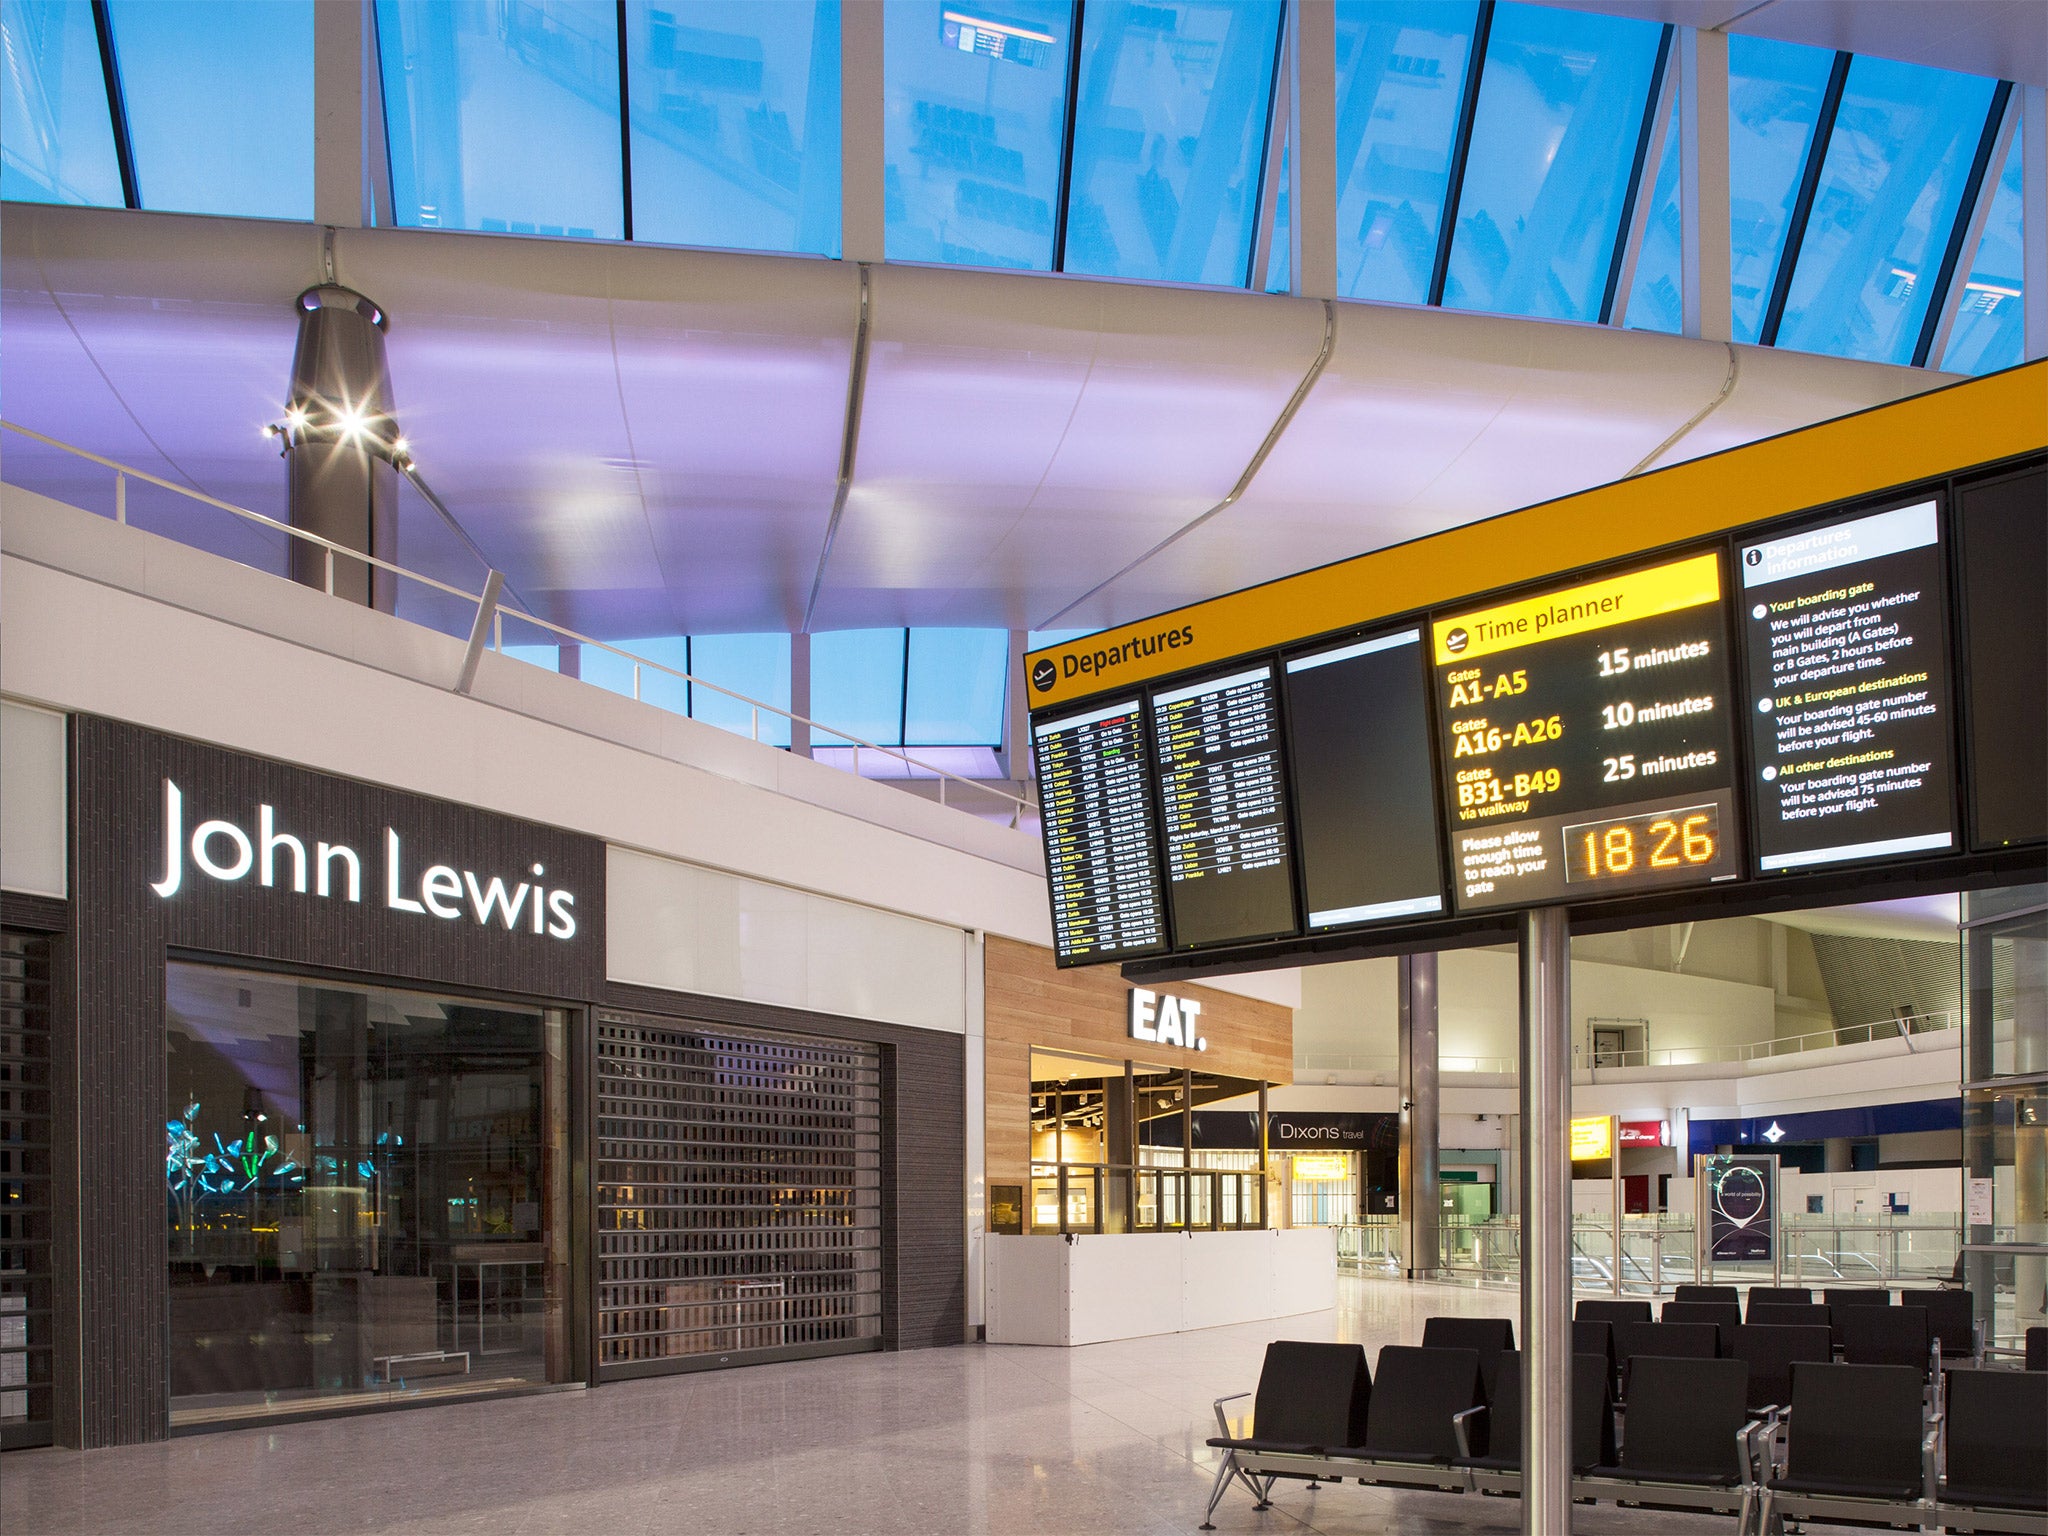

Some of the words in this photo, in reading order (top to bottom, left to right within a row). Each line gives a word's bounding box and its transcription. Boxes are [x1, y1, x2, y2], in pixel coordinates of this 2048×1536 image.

[1766, 528, 1851, 560] Departures
[1767, 543, 1858, 575] information
[1770, 600, 1796, 612] Your
[1798, 589, 1847, 607] boarding
[1848, 583, 1874, 597] gate
[1771, 620, 1789, 631] We
[1790, 614, 1810, 627] will
[1812, 608, 1846, 622] advise
[1848, 603, 1869, 617] you
[1871, 592, 1920, 609] whether
[1475, 617, 1528, 642] Time
[1535, 594, 1624, 634] planner
[1771, 634, 1791, 647] you
[1793, 627, 1813, 640] will
[1815, 620, 1852, 635] depart
[1853, 615, 1881, 627] from
[1063, 625, 1194, 679] Departures
[1773, 645, 1799, 658] main
[1801, 636, 1846, 652] building
[1848, 631, 1861, 644] (A
[1862, 623, 1899, 639] Gates)
[1773, 662, 1785, 671] or
[1787, 659, 1794, 669] B
[1796, 654, 1829, 667] Gates,
[1832, 650, 1839, 660] 2
[1841, 645, 1873, 658] hours
[1875, 637, 1913, 651] before
[1598, 648, 1630, 676] 15
[1634, 641, 1709, 669] minutes
[1774, 674, 1798, 688] your
[1800, 663, 1854, 680] departure
[1856, 657, 1885, 669] time.
[1448, 668, 1481, 683] Gates
[1450, 670, 1527, 708] A1-A5
[1776, 696, 1792, 708] UK
[1794, 695, 1802, 704] &
[1805, 686, 1856, 702] European
[1858, 672, 1927, 692] destinations
[1602, 702, 1634, 729] 10
[1638, 696, 1713, 722] minutes
[1776, 715, 1802, 726] Your
[1804, 705, 1853, 721] boarding
[1855, 700, 1881, 714] gate
[1883, 692, 1928, 707] number
[1777, 727, 1796, 739] will
[1798, 726, 1812, 736] be
[1814, 717, 1855, 733] advised
[1857, 711, 1888, 725] 45-60
[1890, 704, 1936, 720] minutes
[1452, 718, 1488, 734] Gates
[1454, 716, 1562, 758] A16-A26
[1778, 740, 1813, 753] before
[1815, 735, 1840, 749] your
[1841, 729, 1874, 743] flight.
[1456, 768, 1492, 783] Gates
[1604, 755, 1635, 782] 25
[1642, 751, 1716, 775] minutes
[1779, 764, 1794, 776] All
[1796, 761, 1825, 773] other
[1826, 750, 1894, 768] destinations
[1780, 782, 1806, 793] Your
[1808, 775, 1857, 789] boarding
[1859, 770, 1884, 783] gate
[1886, 763, 1931, 777] number
[1459, 769, 1560, 807] B31-B49
[1781, 795, 1800, 806] will
[1802, 794, 1816, 803] be
[1817, 786, 1858, 801] advised
[1860, 784, 1874, 795] 75
[1876, 778, 1921, 792] minutes
[1460, 808, 1477, 820] via
[1478, 800, 1529, 817] walkway
[1782, 808, 1817, 820] before
[1819, 804, 1843, 817] your
[1845, 798, 1878, 811] flight.
[1230, 823, 1241, 831] 2014
[1463, 836, 1501, 851] Please
[1502, 831, 1539, 846] allow
[151, 777, 360, 903] John
[386, 826, 577, 940] Lewis
[1464, 849, 1506, 866] enough
[1507, 845, 1542, 859] time
[1585, 826, 1635, 876] 18
[1649, 814, 1714, 868] 26
[1464, 869, 1479, 880] to
[1481, 862, 1515, 878] reach
[1516, 860, 1547, 876] your
[1466, 881, 1494, 897] gate
[1131, 987, 1207, 1052] EAT.
[1280, 1123, 1340, 1139] Dixons
[1342, 1130, 1364, 1139] travel
